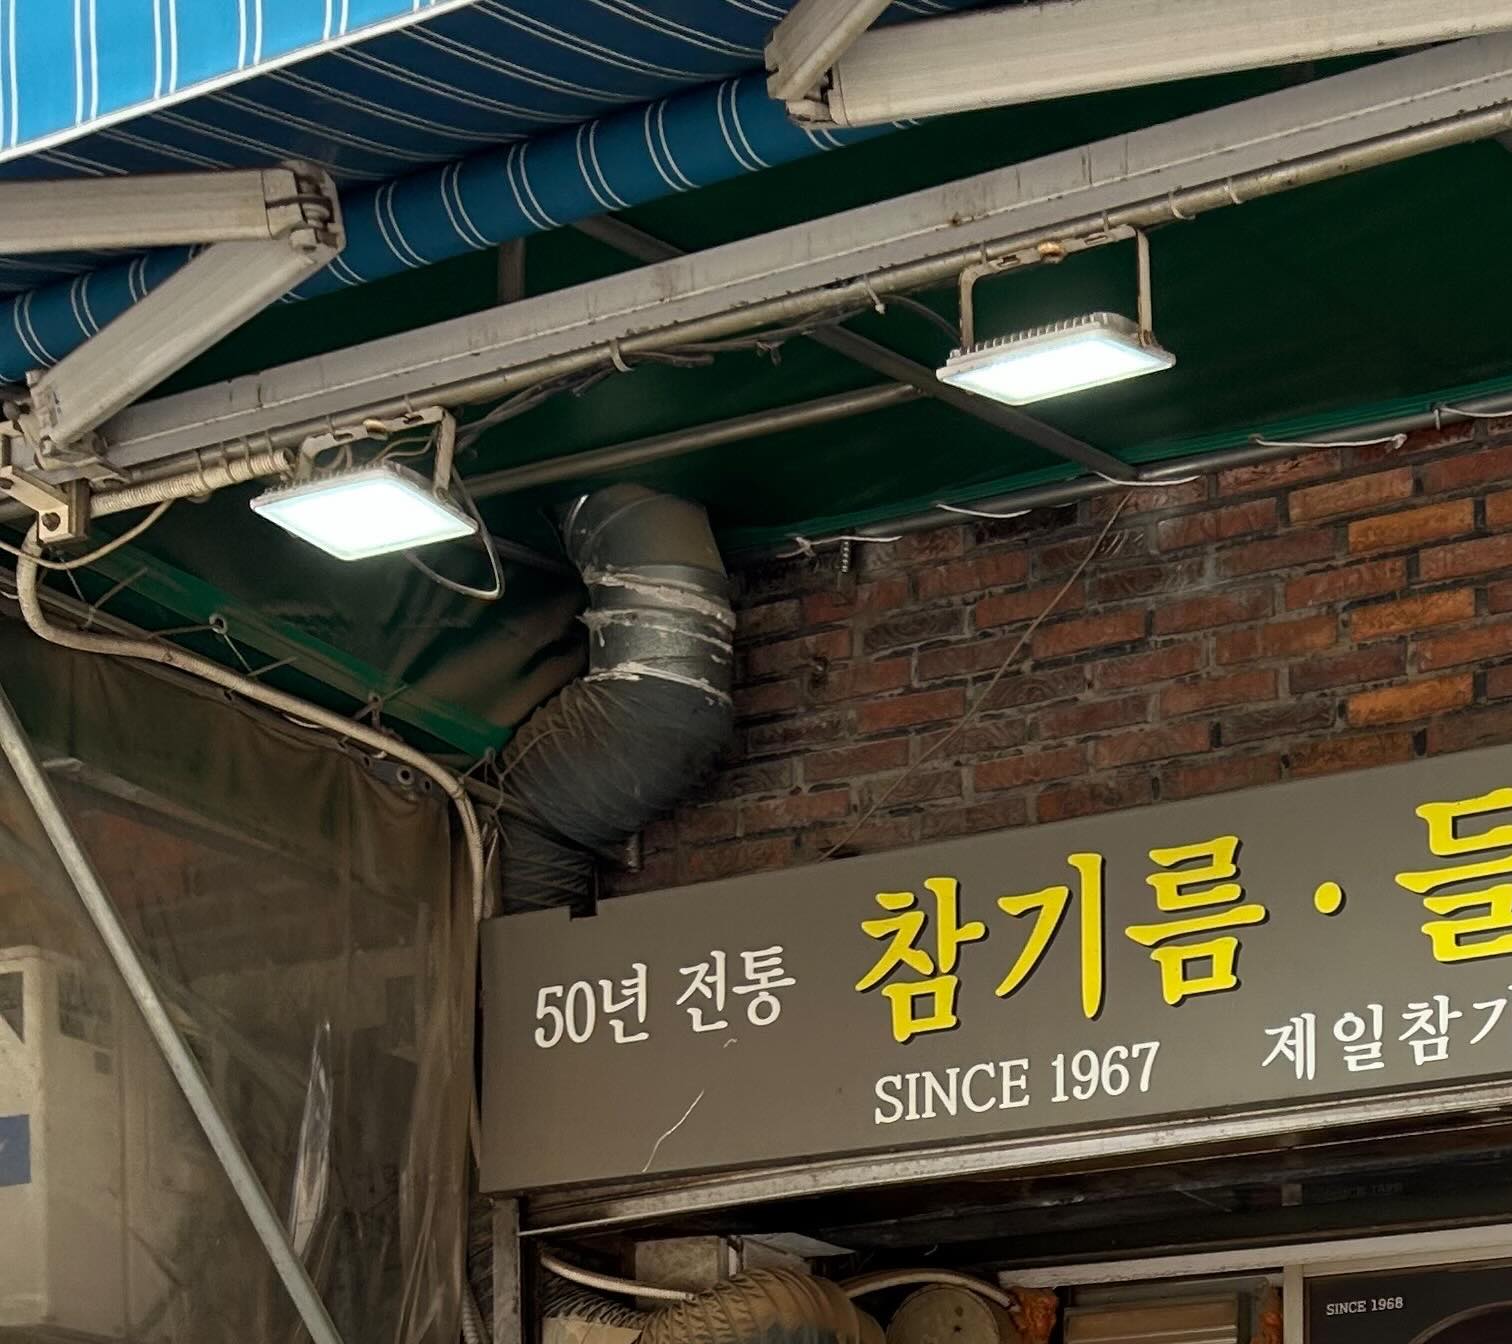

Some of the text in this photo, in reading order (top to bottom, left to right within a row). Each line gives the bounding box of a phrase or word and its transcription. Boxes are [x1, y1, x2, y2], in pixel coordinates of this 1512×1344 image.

[855, 835, 1269, 1043] 참기름
[534, 943, 798, 1048] 50년 전통
[873, 1040, 1161, 1126] SINCE 1967
[1326, 1297, 1403, 1316] SINCE 1968
